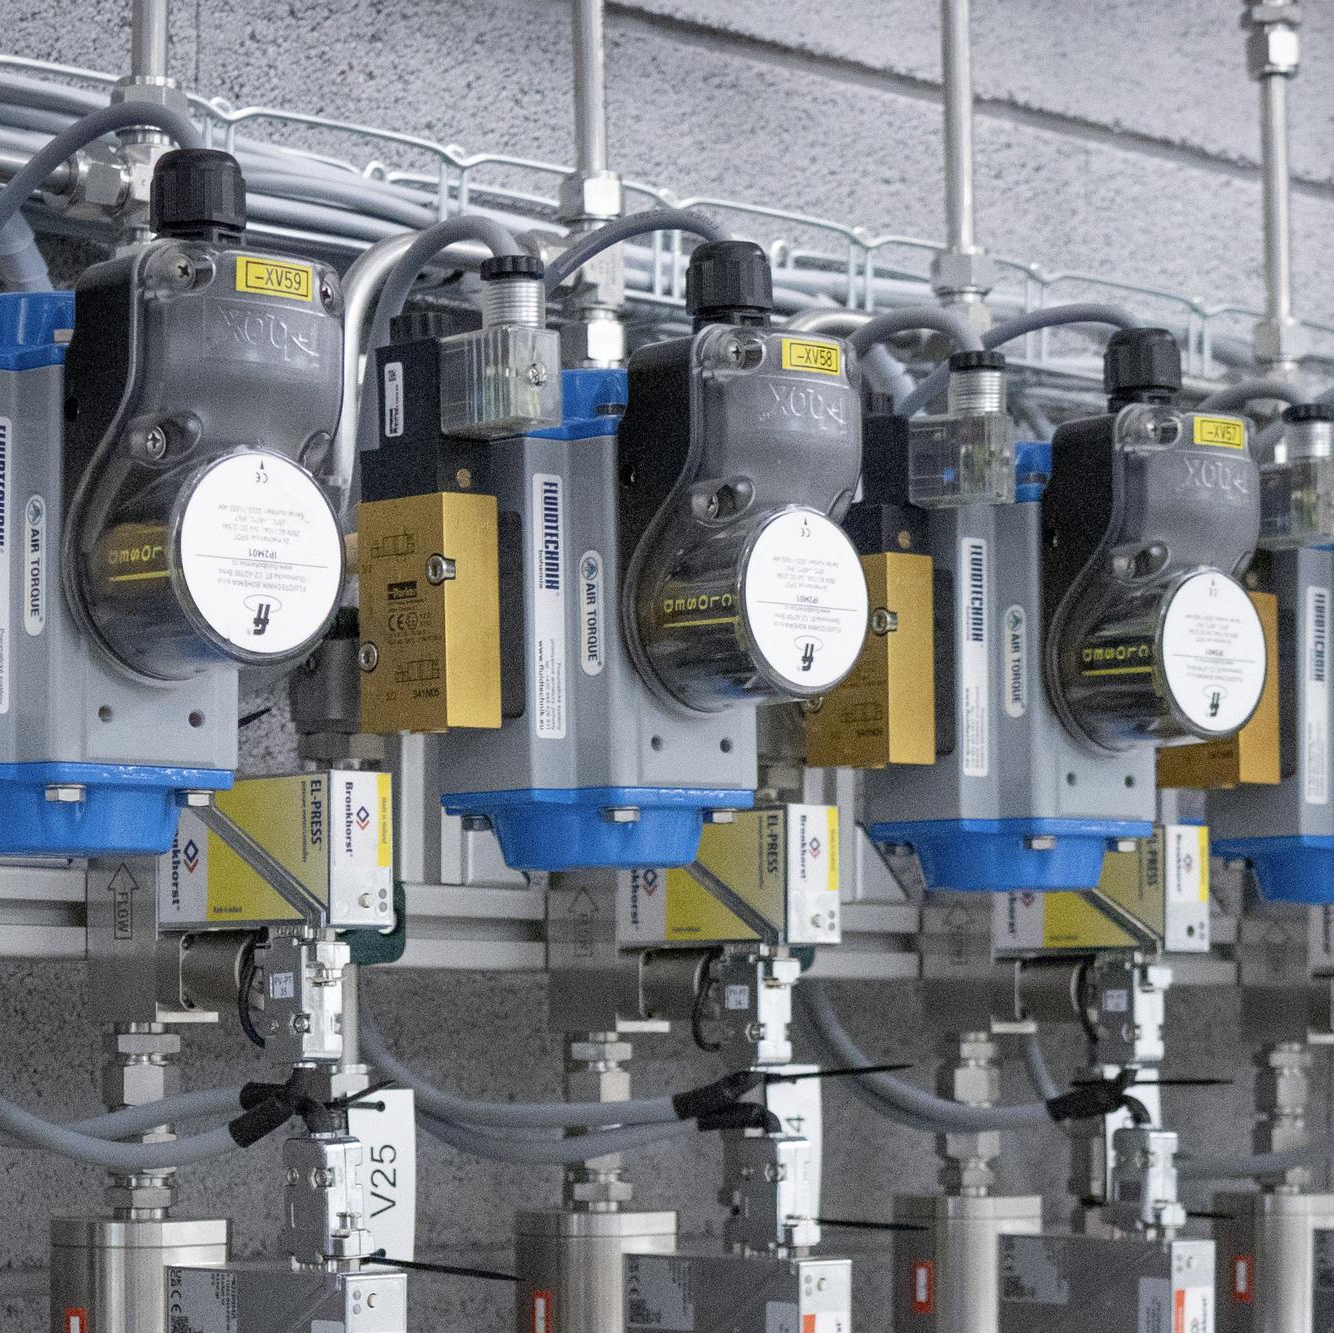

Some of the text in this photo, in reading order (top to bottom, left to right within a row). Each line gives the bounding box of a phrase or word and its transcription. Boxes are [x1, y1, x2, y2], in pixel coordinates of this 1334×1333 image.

[254, 270, 302, 291] -XV59
[796, 351, 835, 369] -XV58
[248, 548, 277, 559] IP2M01
[543, 482, 559, 591] FLUIDTECHNIK
[30, 528, 41, 617] AIR TORQUE
[664, 593, 731, 613] CLOSED
[970, 545, 983, 642] FLUIDTECHNIK
[586, 583, 598, 661] AIR TORQUE
[1012, 634, 1021, 704] AIR TORQUE
[310, 780, 322, 844] EL-PRESS
[345, 781, 353, 855] Bronkhorst
[768, 815, 779, 873] EL-PRESS
[171, 832, 180, 905] nkhorst
[368, 1142, 399, 1218] V25
